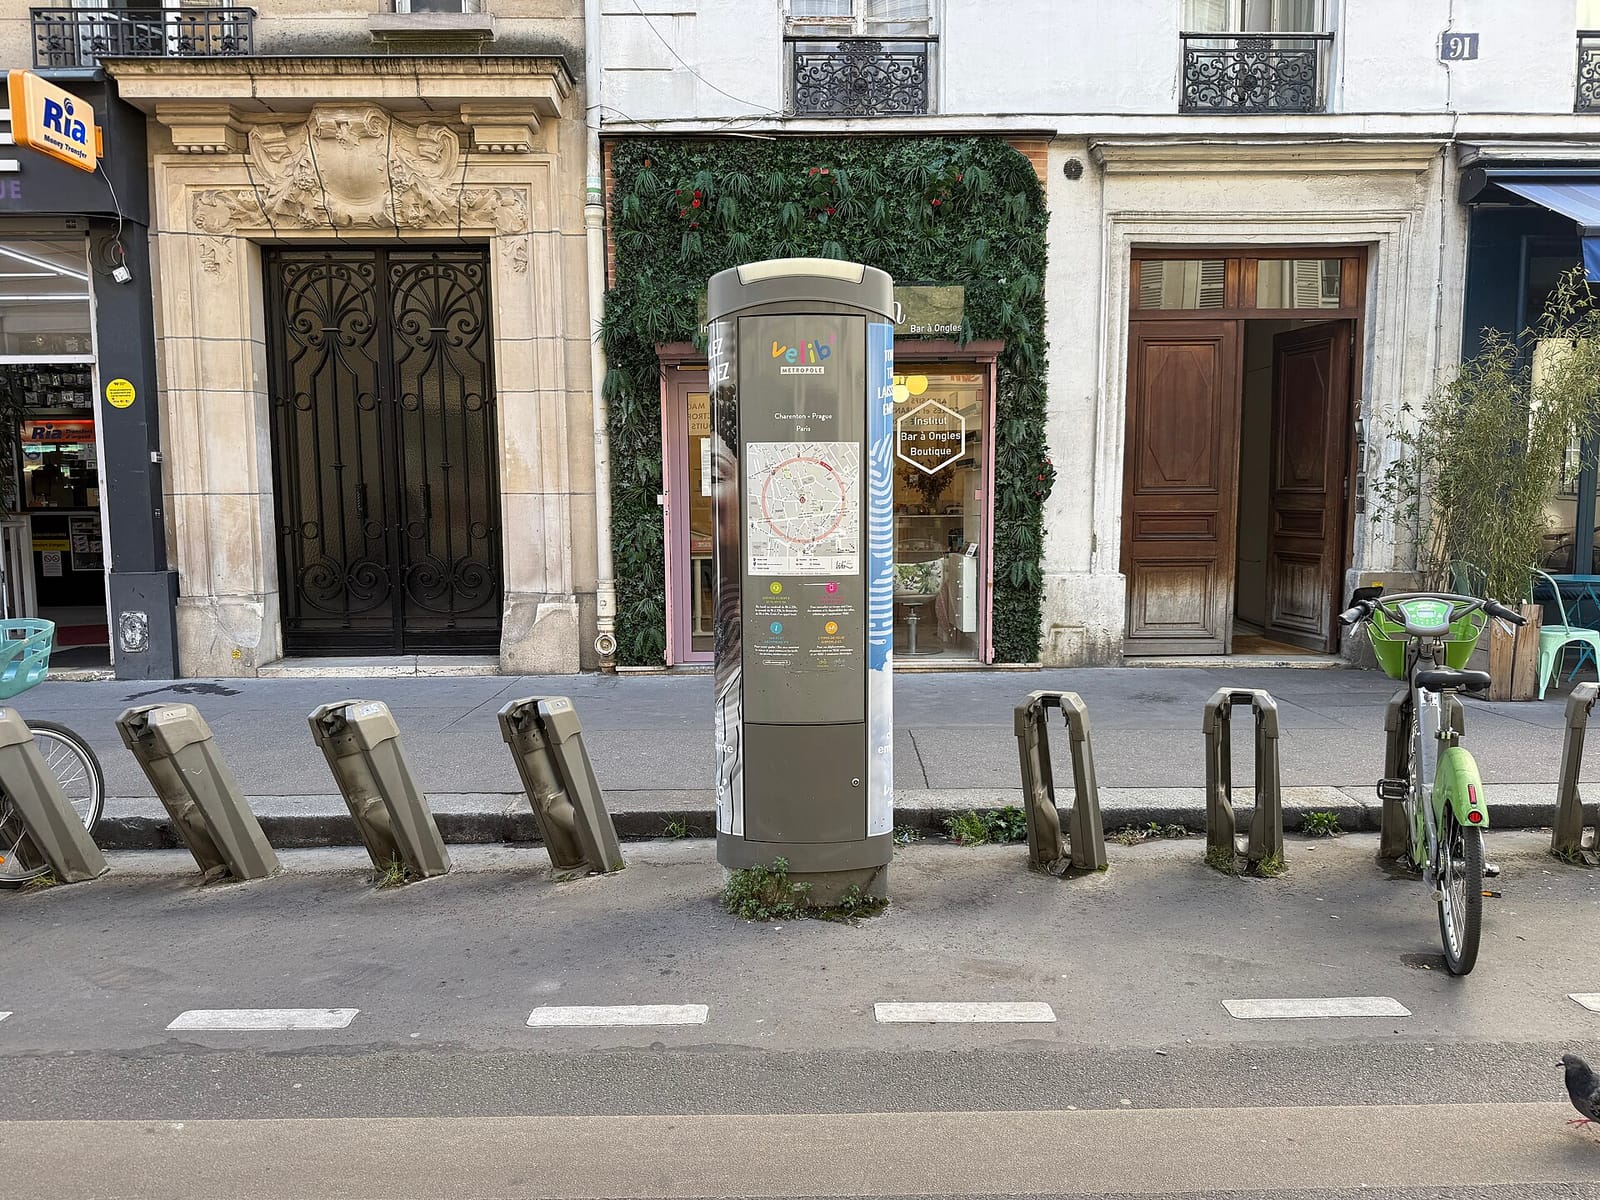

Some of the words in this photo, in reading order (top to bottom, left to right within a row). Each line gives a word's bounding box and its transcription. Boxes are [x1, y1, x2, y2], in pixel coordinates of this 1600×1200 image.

[1450, 37, 1471, 58] 91
[43, 97, 86, 145] Ria
[44, 134, 64, 150] Money
[65, 143, 88, 159] Transfer
[910, 325, 924, 333] Bar
[926, 324, 932, 333] à
[934, 324, 962, 334] Ongles
[774, 412, 806, 420] Charenton
[812, 412, 833, 421] Prague
[914, 416, 947, 425] Institut
[32, 422, 63, 440] Ria
[901, 432, 917, 441] Bar
[920, 431, 926, 441] à
[929, 431, 961, 442] Ongles
[910, 446, 952, 457] Boutique
